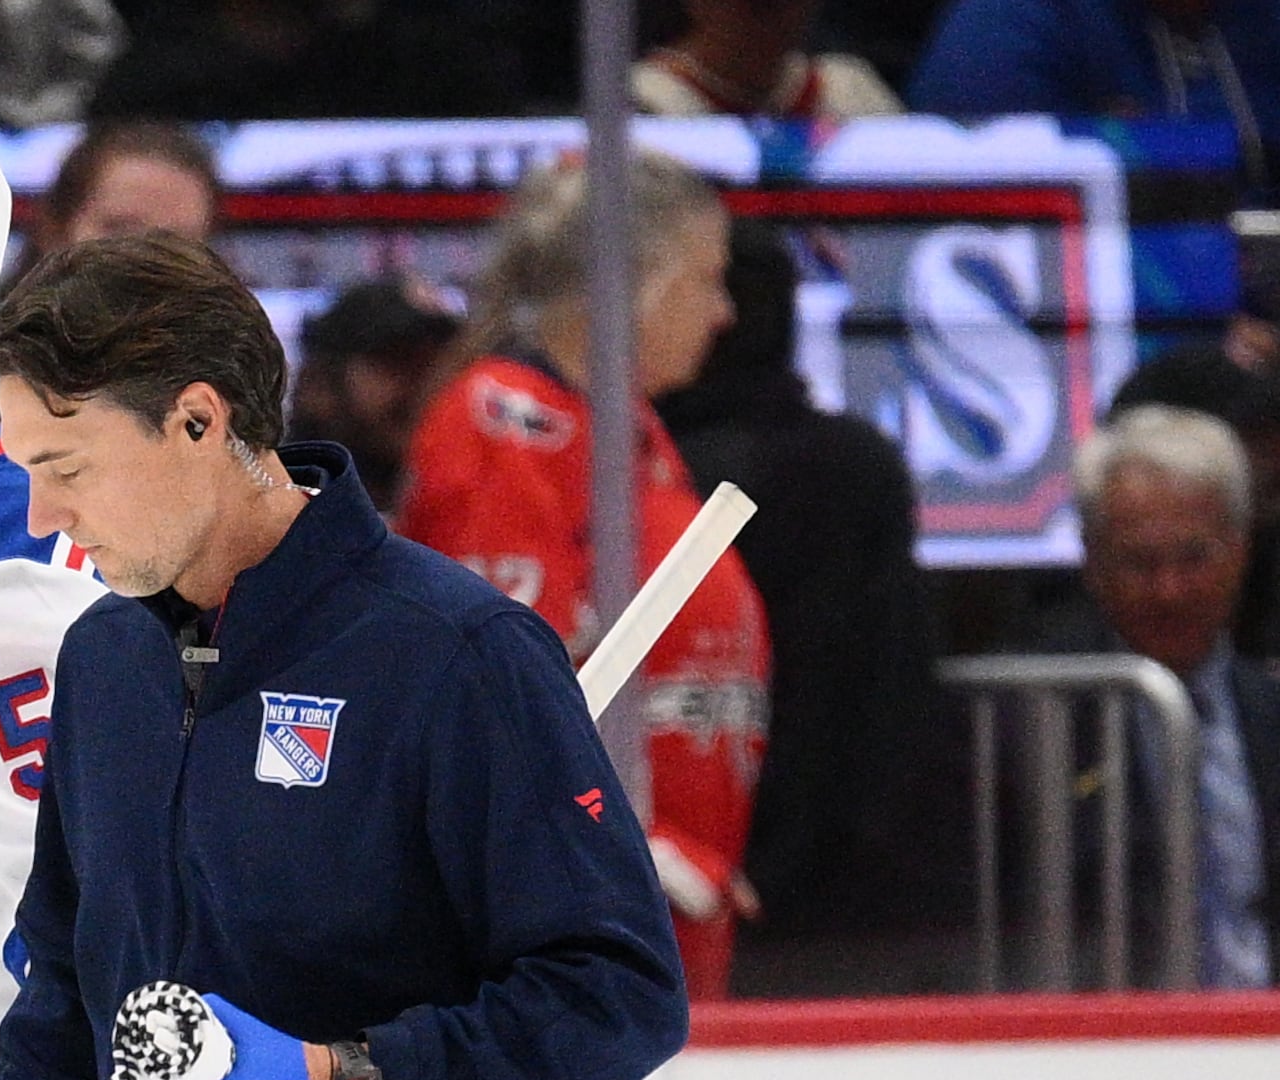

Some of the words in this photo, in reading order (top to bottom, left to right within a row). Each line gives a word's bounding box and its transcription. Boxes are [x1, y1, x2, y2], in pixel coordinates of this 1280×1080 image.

[268, 703, 296, 721] NEW
[299, 706, 332, 725] YORK
[273, 726, 320, 778] RANGERS
